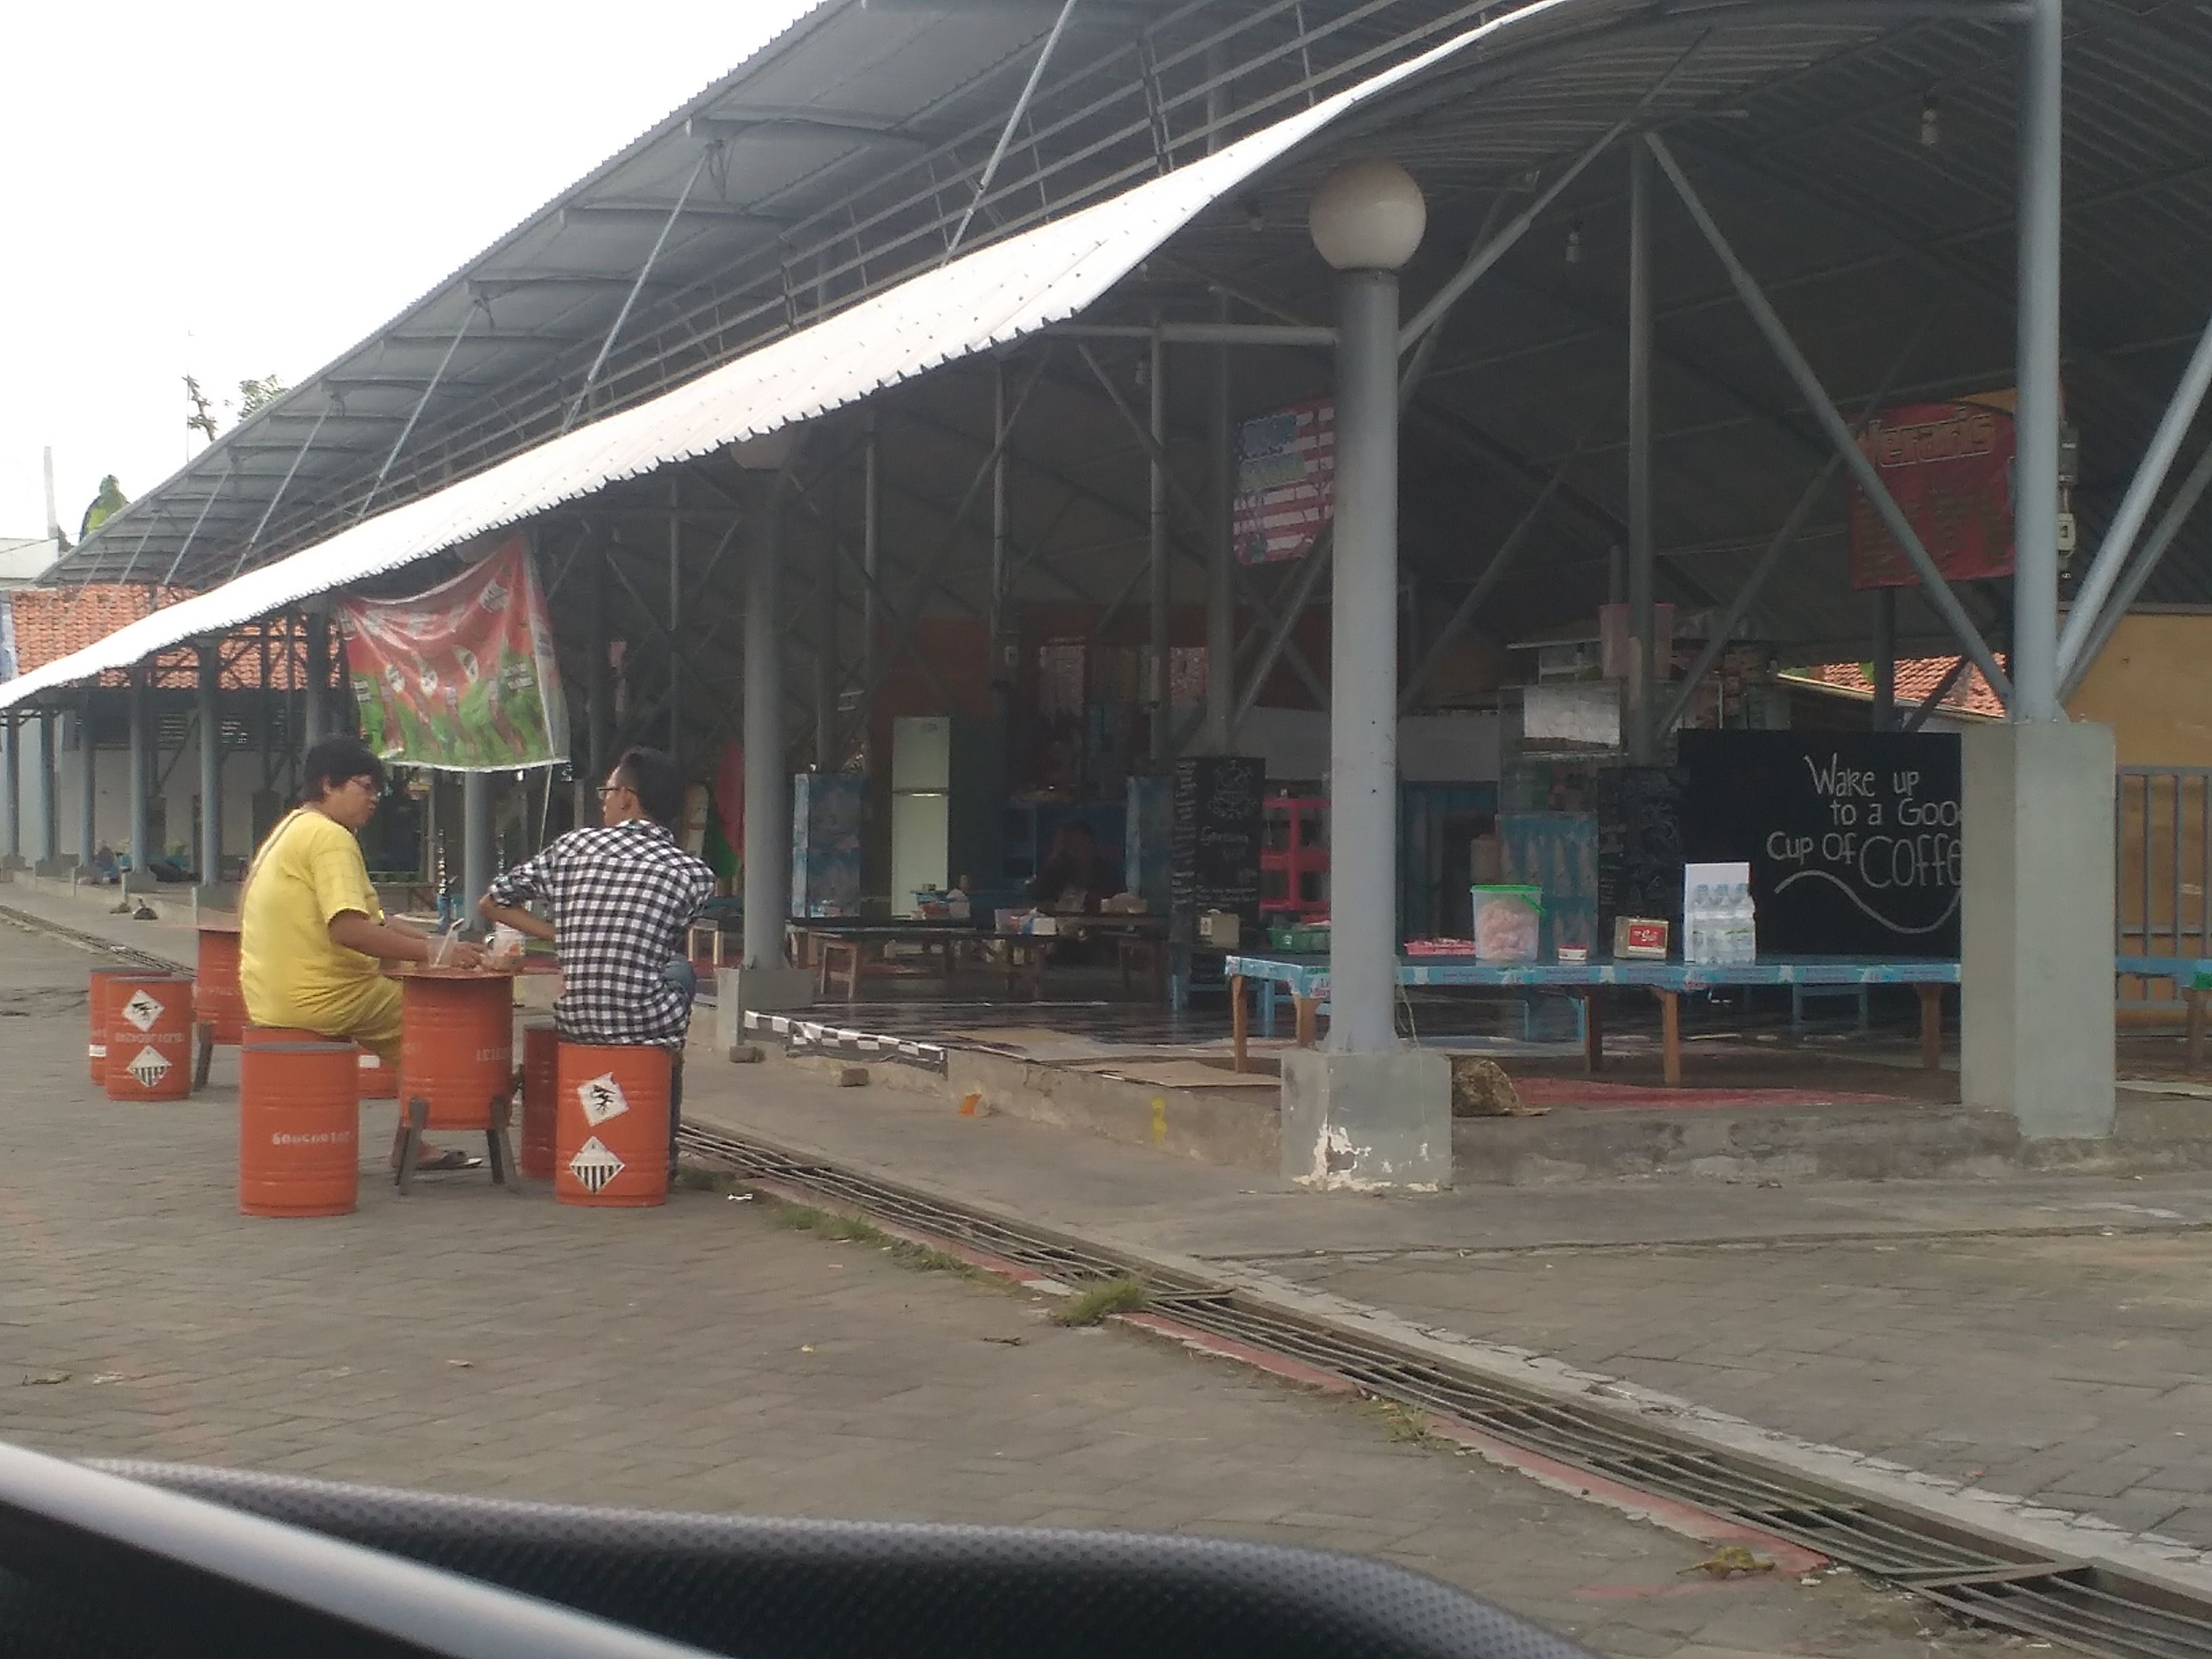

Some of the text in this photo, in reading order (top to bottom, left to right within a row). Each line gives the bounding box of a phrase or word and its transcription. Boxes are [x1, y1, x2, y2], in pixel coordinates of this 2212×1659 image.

[1893, 771, 1920, 796] up
[1830, 798, 1961, 826] to a Goo
[1766, 831, 1814, 865] Cup
